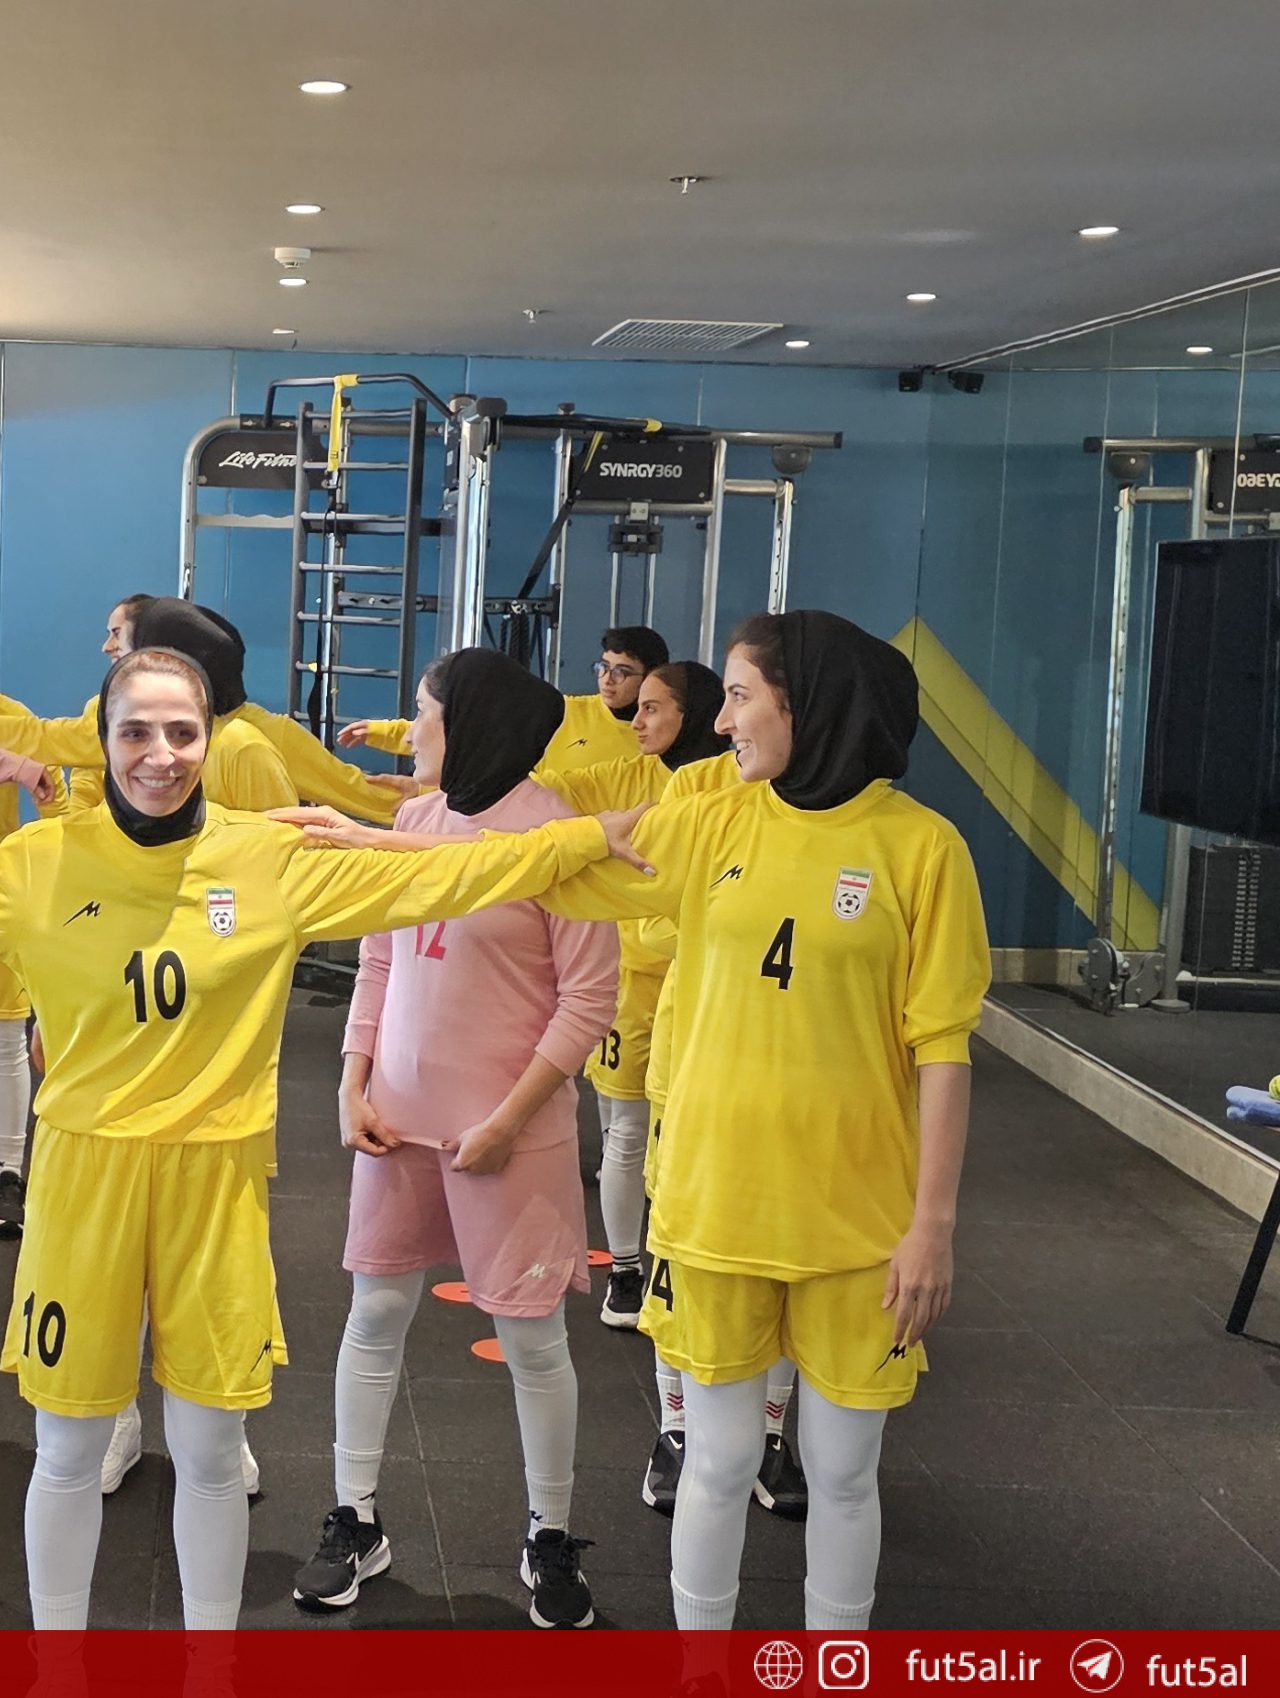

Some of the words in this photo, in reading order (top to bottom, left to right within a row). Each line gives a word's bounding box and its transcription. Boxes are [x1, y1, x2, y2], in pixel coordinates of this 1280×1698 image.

[599, 462, 683, 478] SYNRGY360
[760, 917, 795, 990] 4
[124, 950, 186, 1023] 10
[600, 1029, 621, 1070] 13
[652, 1259, 674, 1312] 4
[23, 1291, 66, 1368] 10
